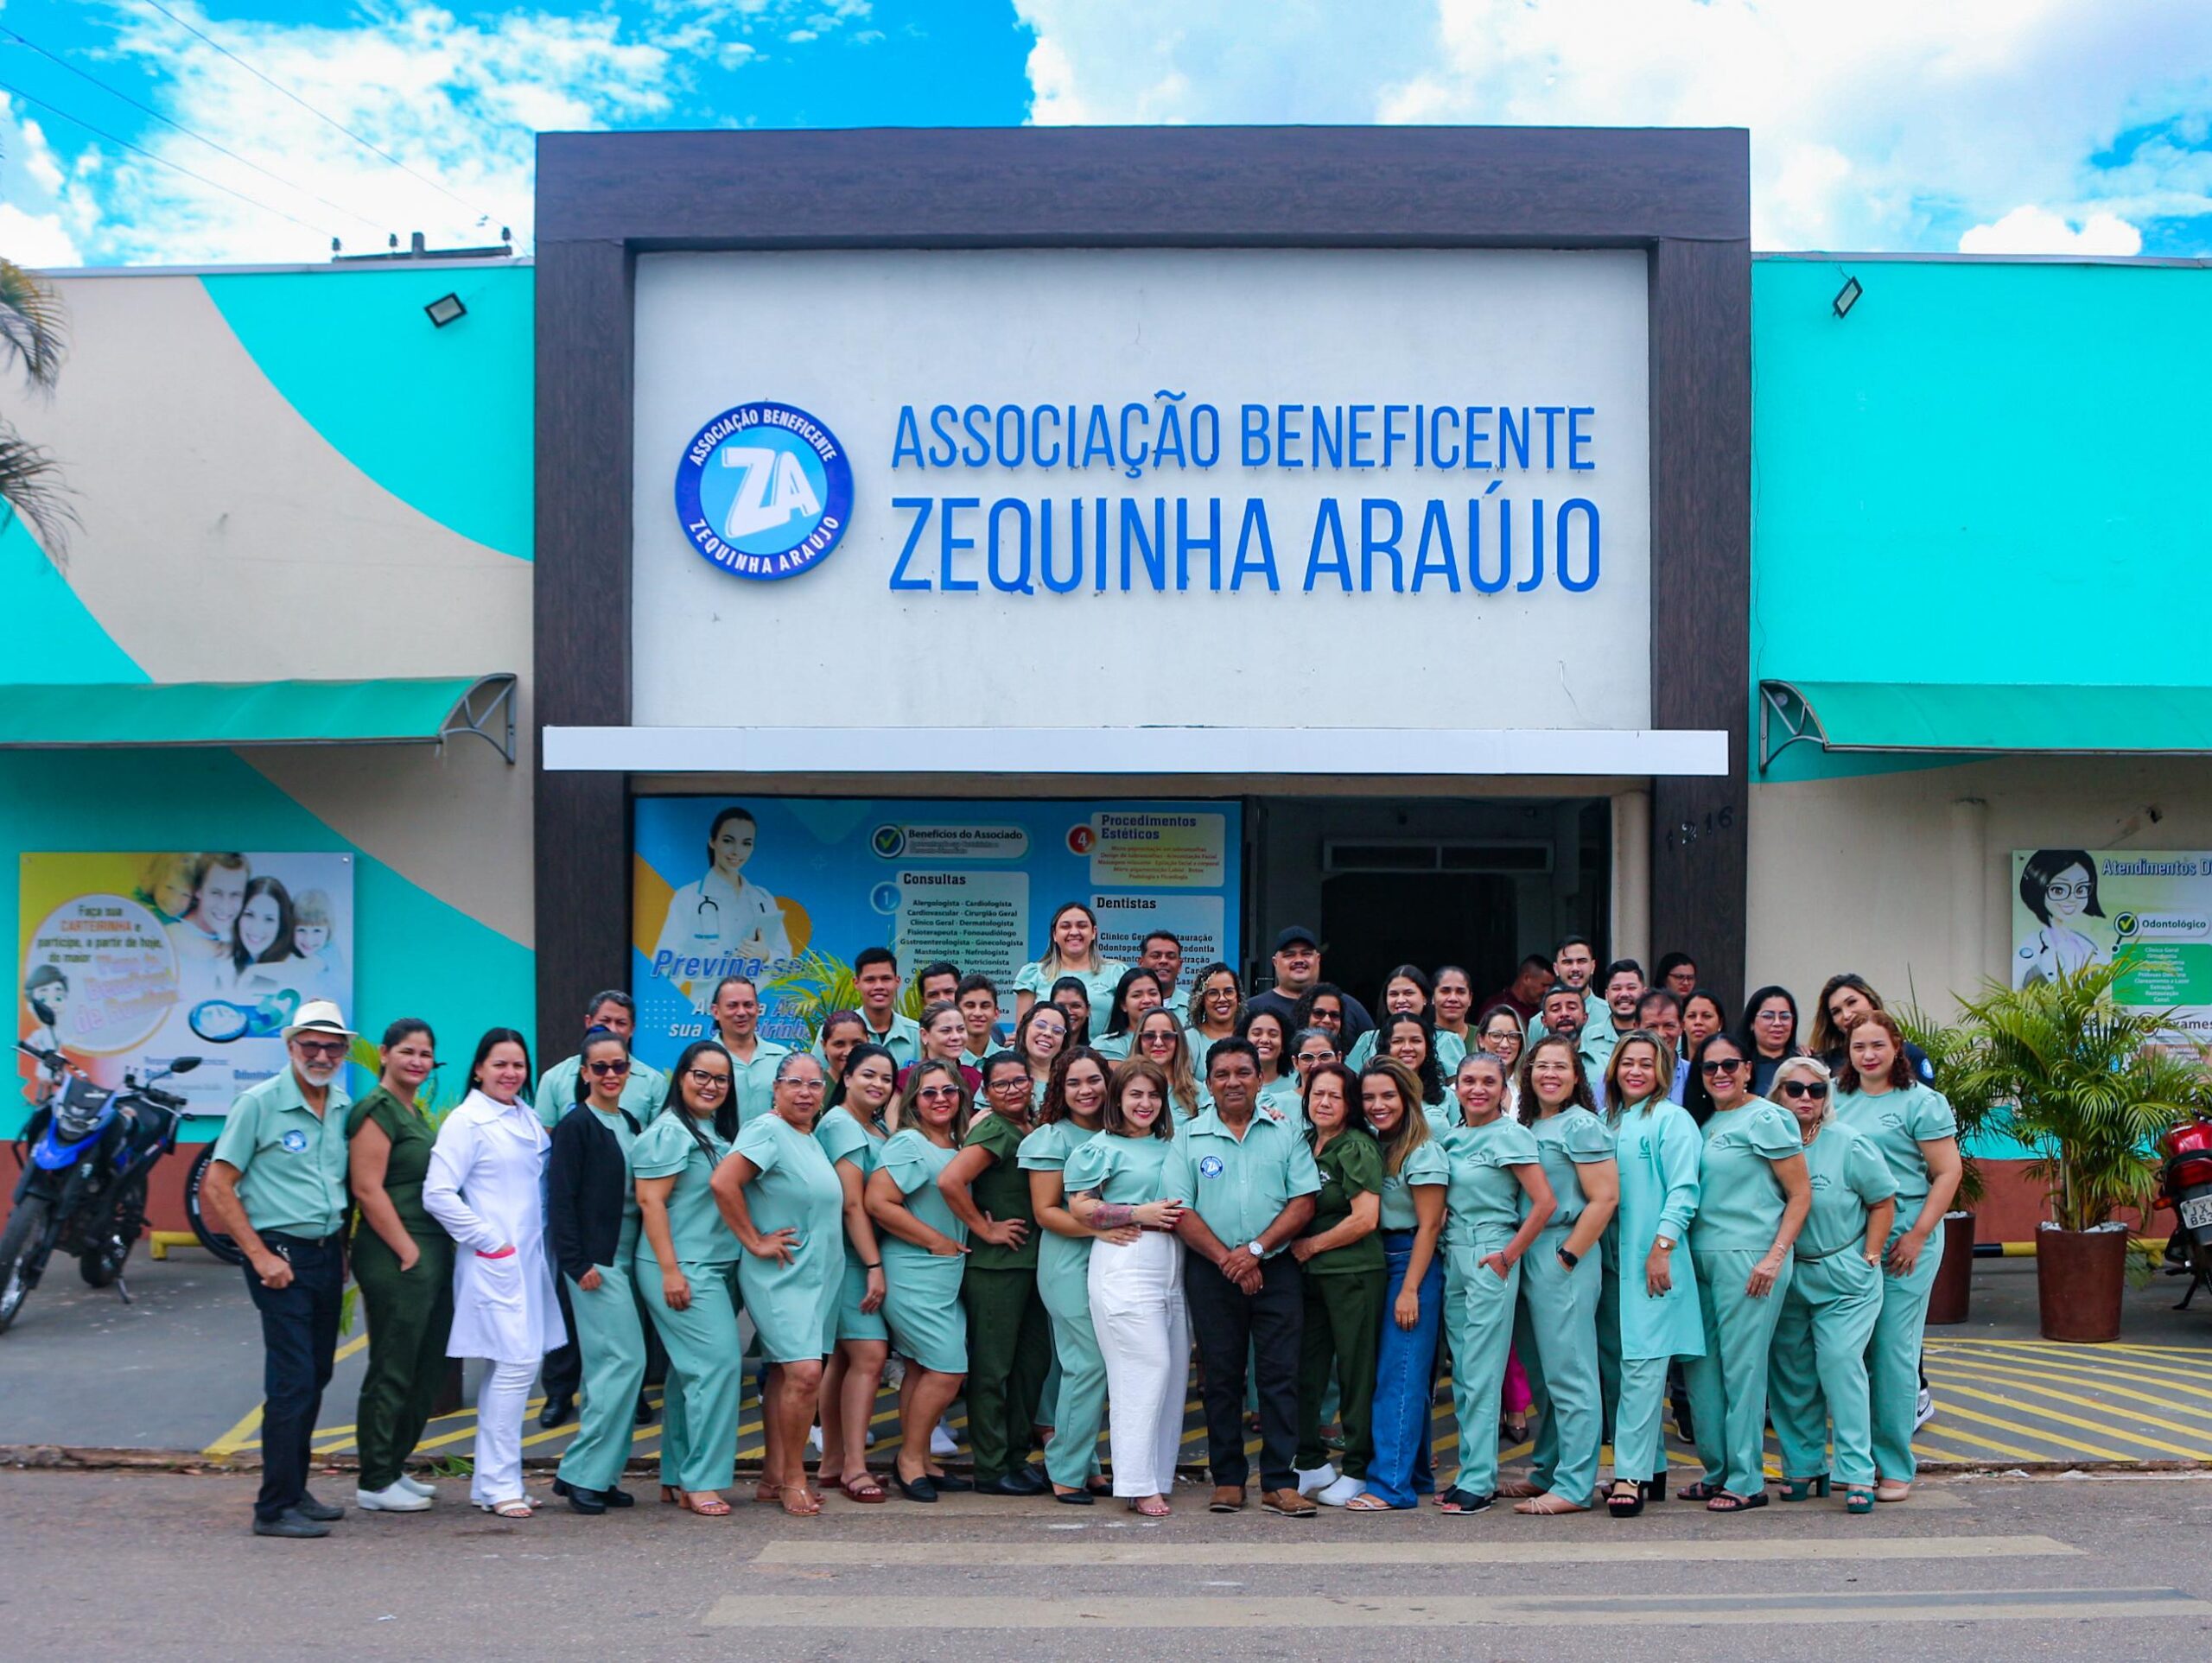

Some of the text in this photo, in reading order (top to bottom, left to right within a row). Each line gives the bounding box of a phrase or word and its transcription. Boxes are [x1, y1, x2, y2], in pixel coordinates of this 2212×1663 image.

[689, 408, 837, 467] ASSOCIAÇÃO BENEFICENTE
[892, 390, 1595, 479] ASSOCIAÇÃO BENEFICENTE
[721, 447, 821, 539] ZA
[889, 480, 1599, 595] ZEQUINHA ARAÚJO
[689, 515, 840, 574] ZEQUINHA ARAÚJO
[1101, 815, 1197, 827] Procedimentos
[959, 829, 972, 838] do
[975, 830, 1023, 840] Associado
[1077, 832, 1087, 847] 4
[1101, 828, 1160, 840] Estéticos
[2102, 859, 2197, 876] Atendimentos
[904, 873, 967, 885] Consultas
[883, 891, 889, 905] 1
[912, 899, 960, 908] Alergologista
[1096, 897, 1157, 909] Dentistas
[2142, 919, 2207, 930] Odontológico
[1177, 934, 1213, 943] tauração
[965, 949, 1009, 957] Nefrologista
[669, 1023, 702, 1038] sua
[2190, 1203, 2212, 1216] JX
